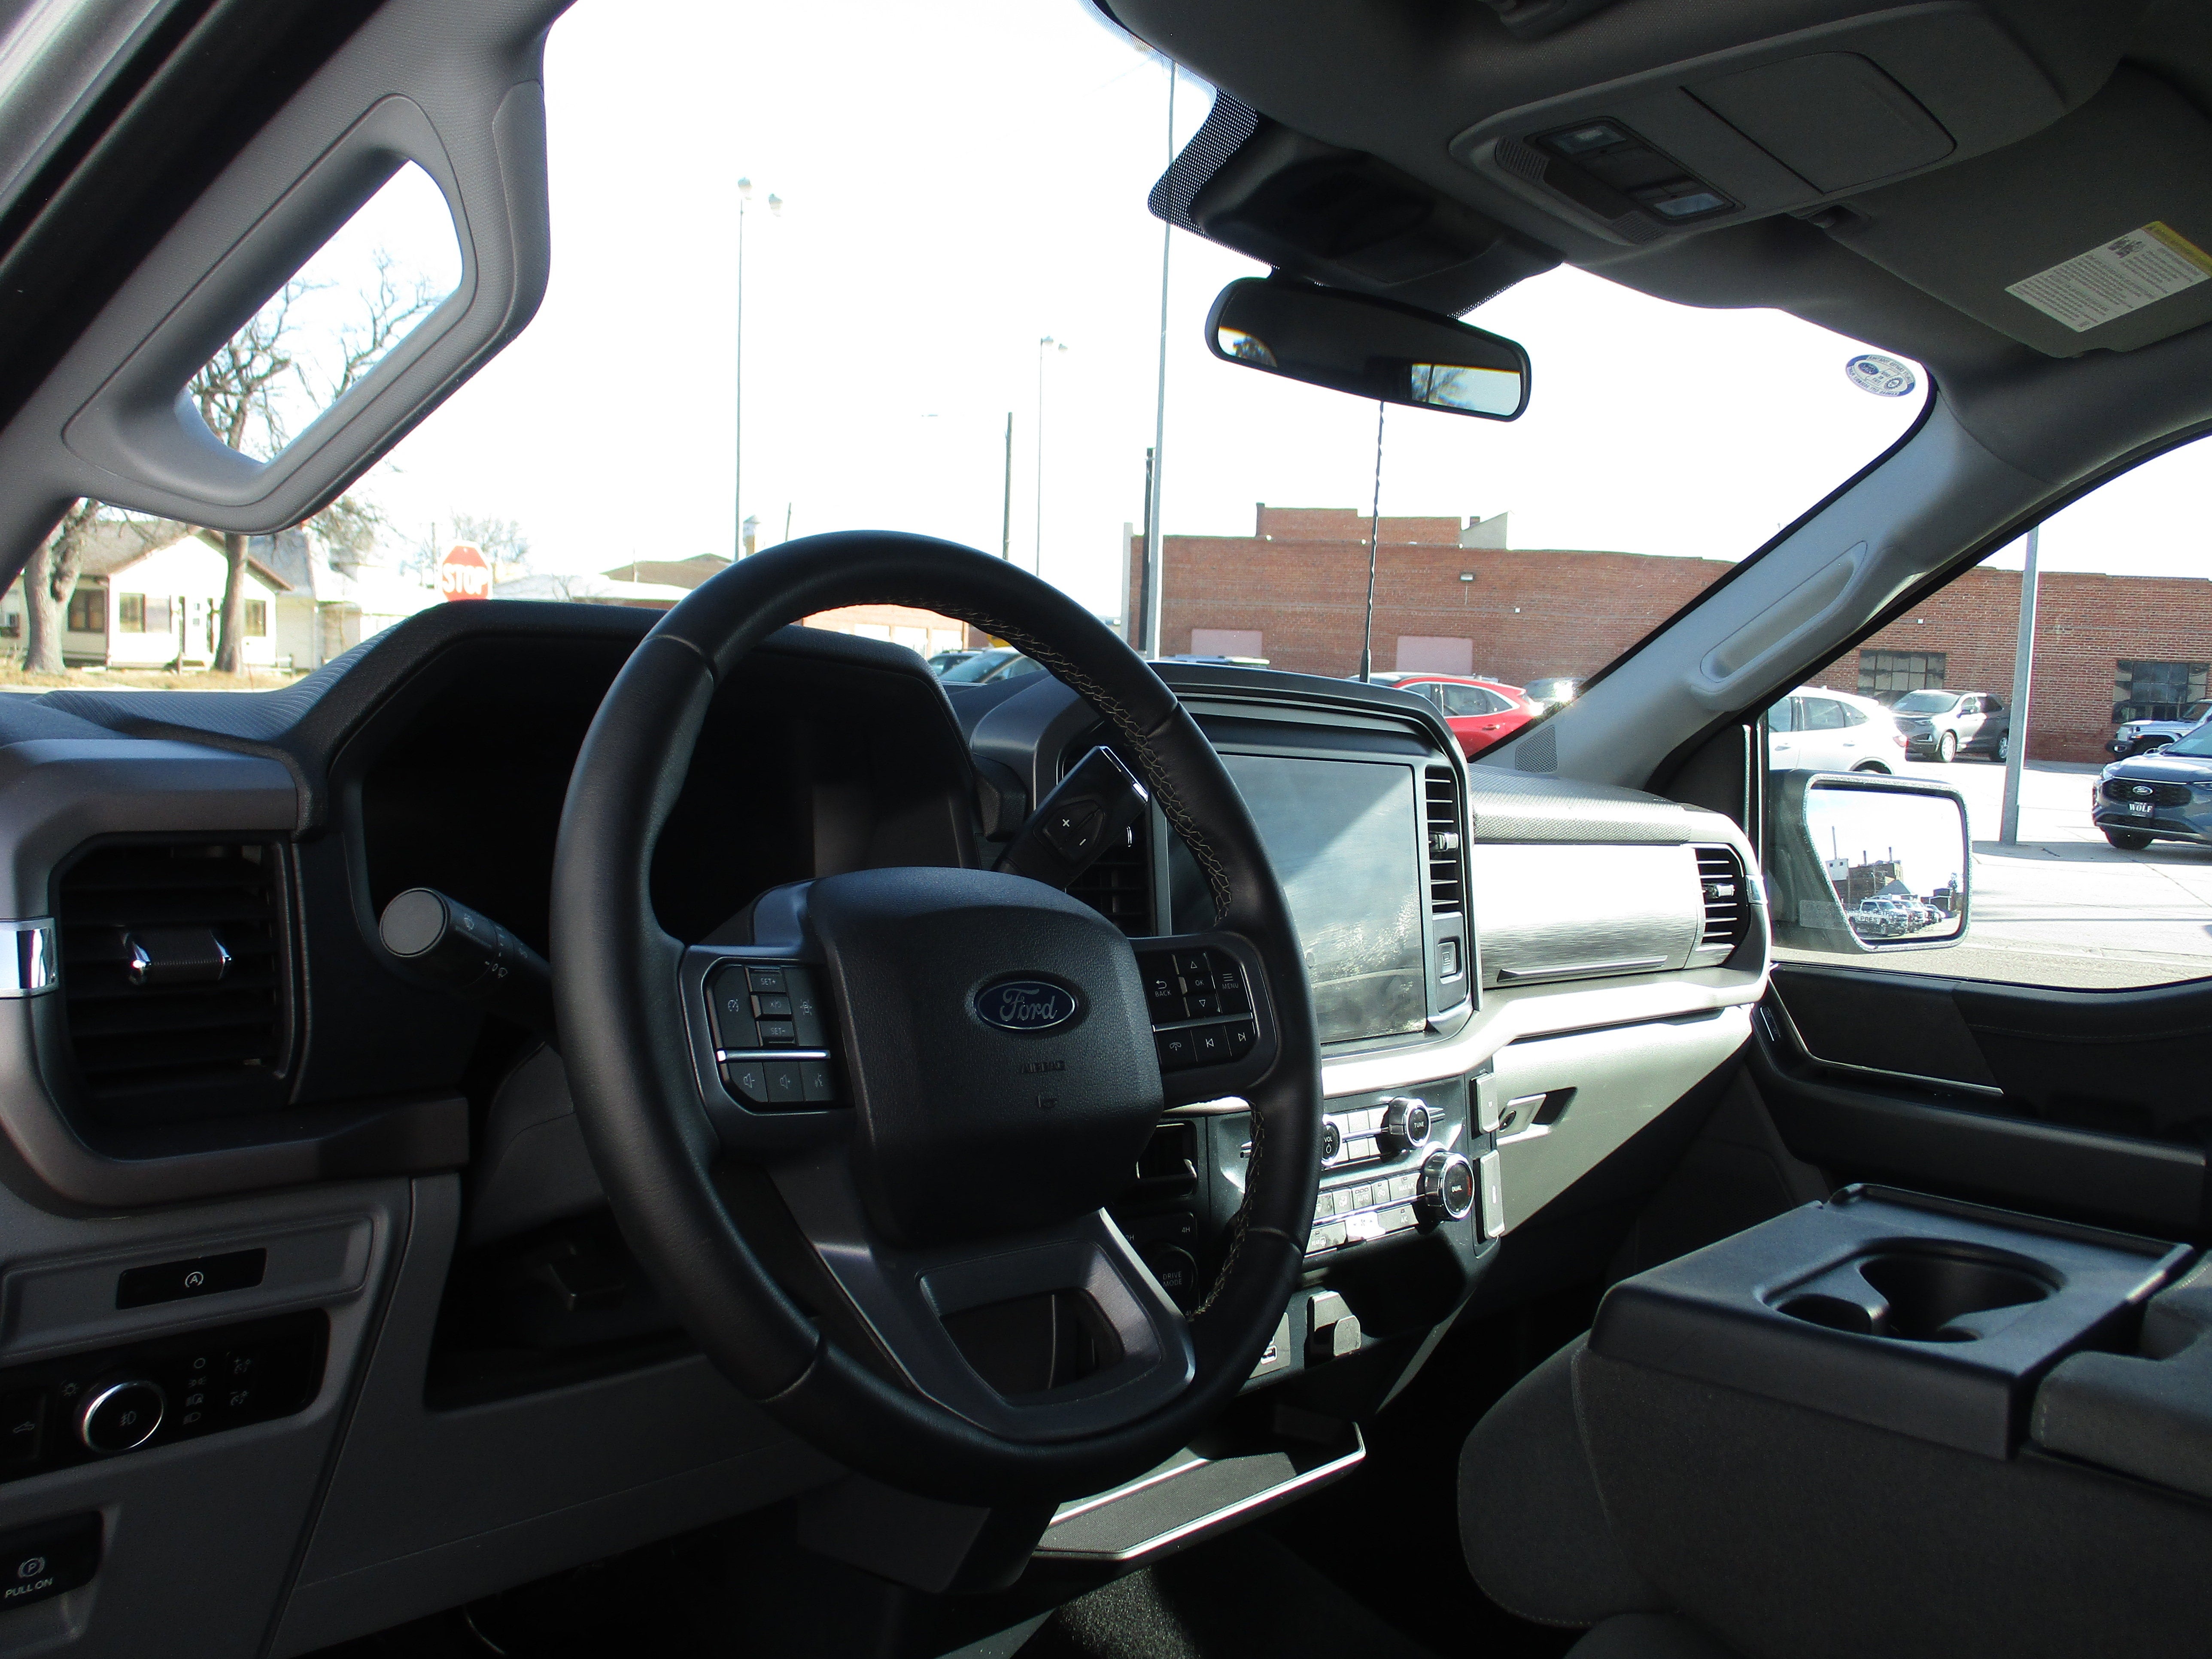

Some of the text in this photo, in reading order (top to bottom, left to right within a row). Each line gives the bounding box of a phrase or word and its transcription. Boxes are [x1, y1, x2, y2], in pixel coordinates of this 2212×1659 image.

[442, 562, 489, 595] STOP
[2129, 803, 2153, 813] WOLF
[1155, 989, 1172, 997] BACK
[999, 988, 1058, 1022] Ford
[1357, 1194, 1369, 1202] AUTO
[1162, 1271, 1182, 1280] DRIVE
[1163, 1278, 1182, 1287] MODE
[4, 1577, 54, 1599] PULL ON
